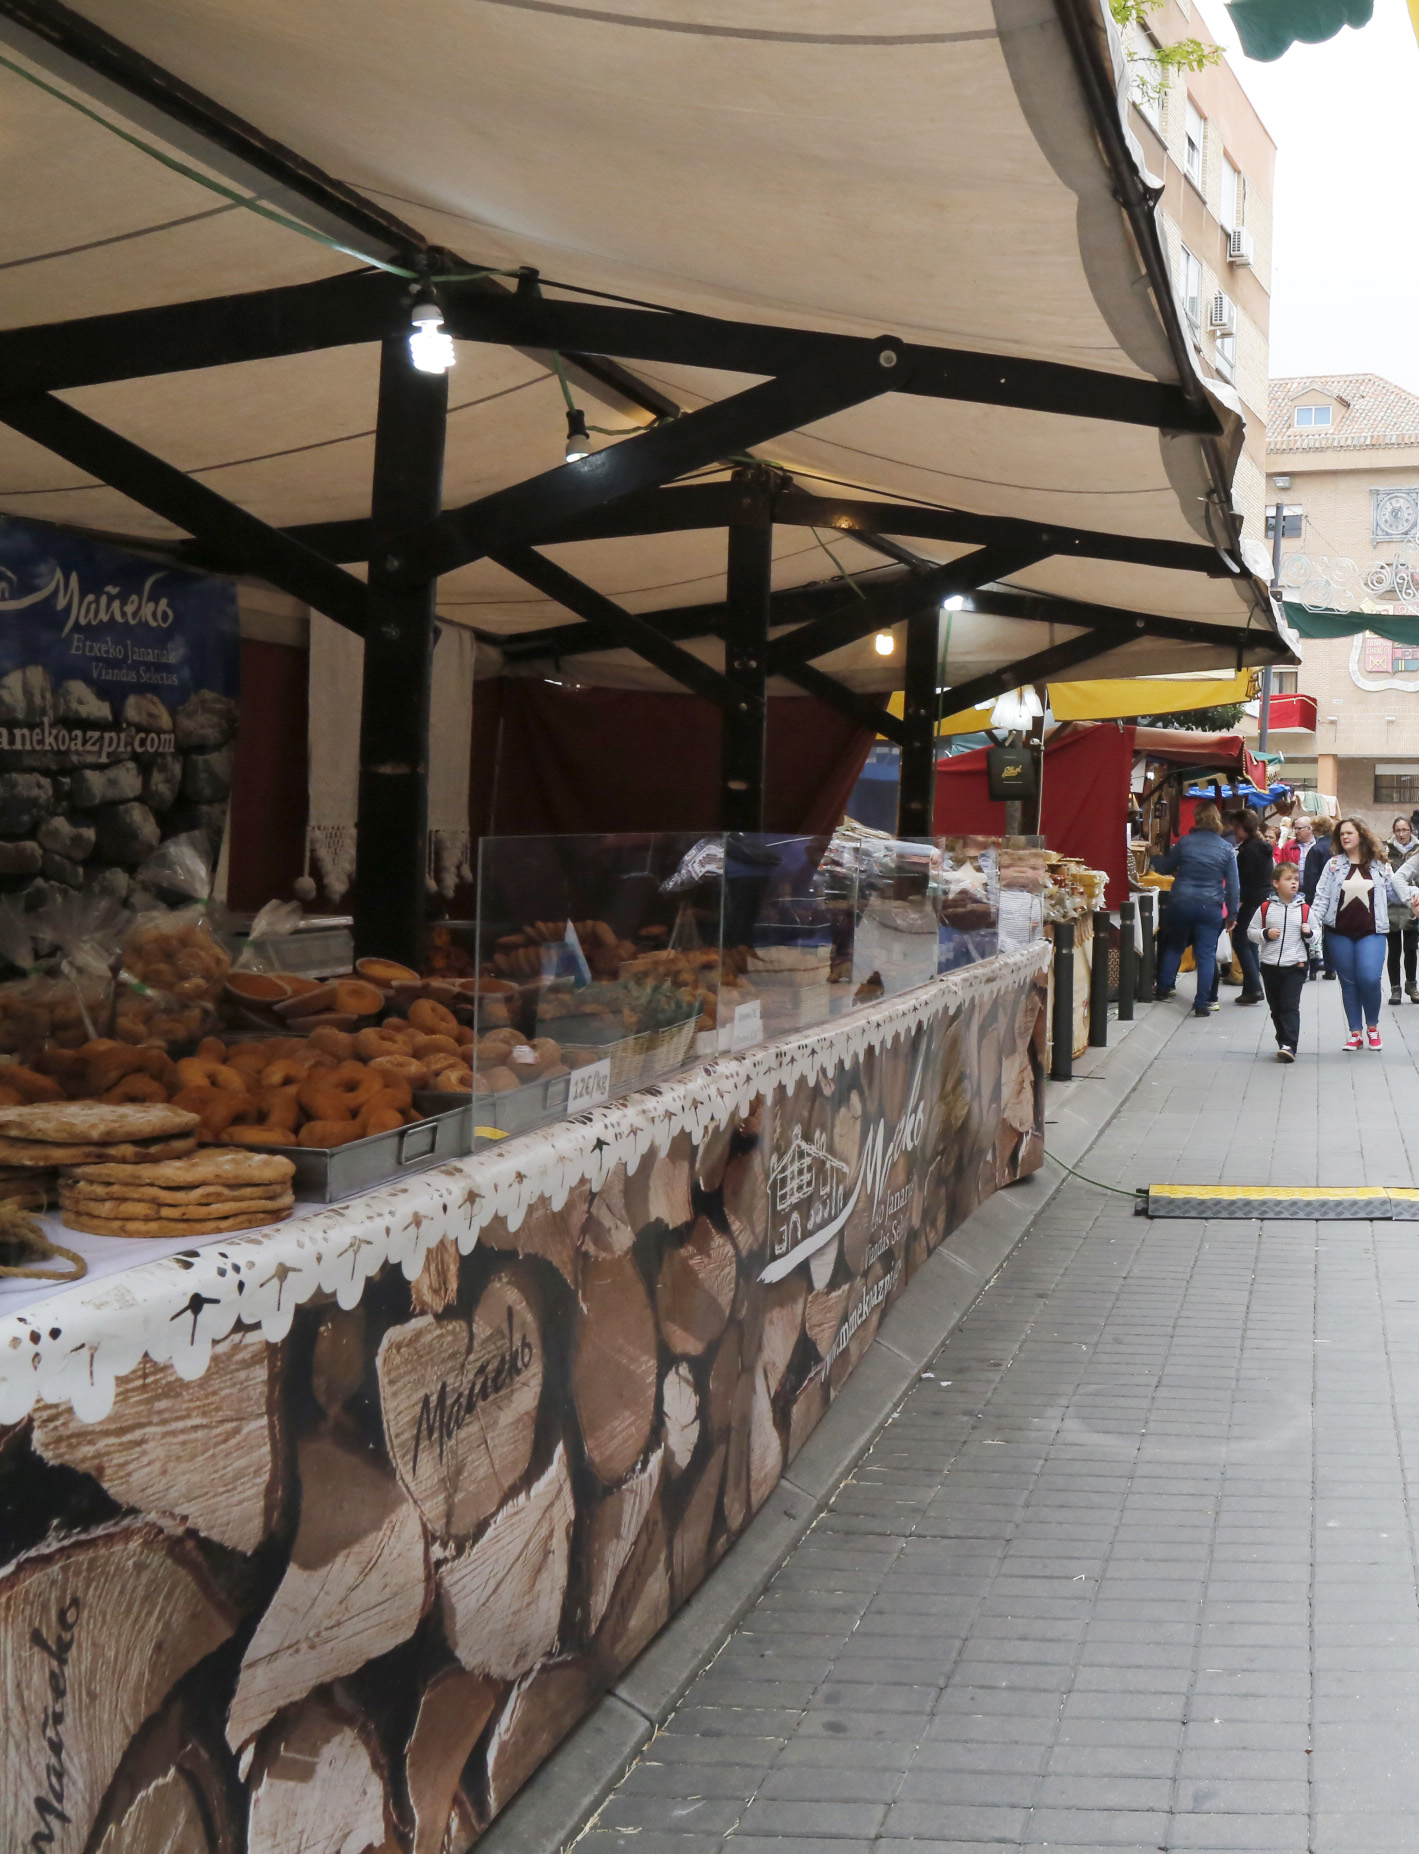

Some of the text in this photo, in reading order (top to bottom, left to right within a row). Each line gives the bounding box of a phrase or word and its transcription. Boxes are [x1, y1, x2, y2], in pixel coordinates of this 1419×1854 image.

[70, 633, 178, 665] Etxeko Janariak
[92, 662, 179, 686] Viandas Selectas
